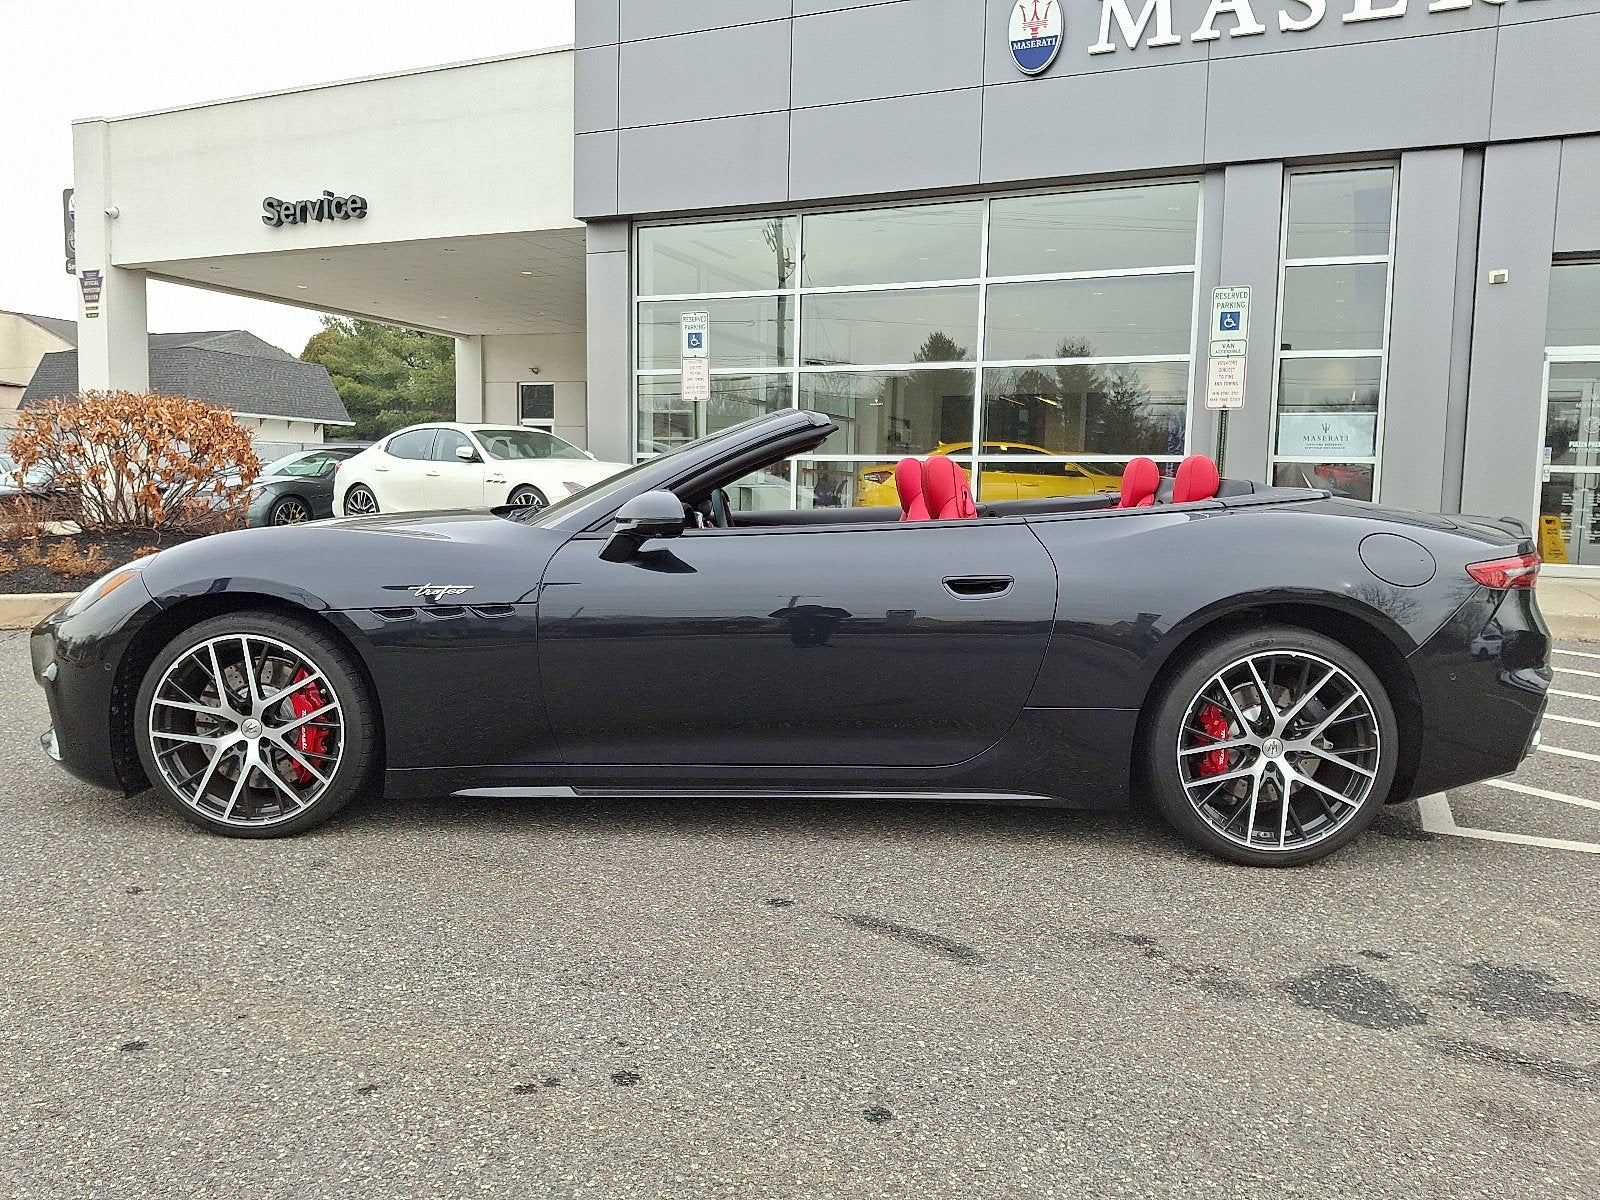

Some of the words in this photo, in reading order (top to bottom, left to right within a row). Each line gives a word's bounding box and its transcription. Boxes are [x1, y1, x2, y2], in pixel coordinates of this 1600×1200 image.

[1012, 38, 1056, 51] MASERATI
[262, 190, 367, 227] Service
[1215, 291, 1248, 300] RESERVED
[1216, 302, 1246, 310] PARKING
